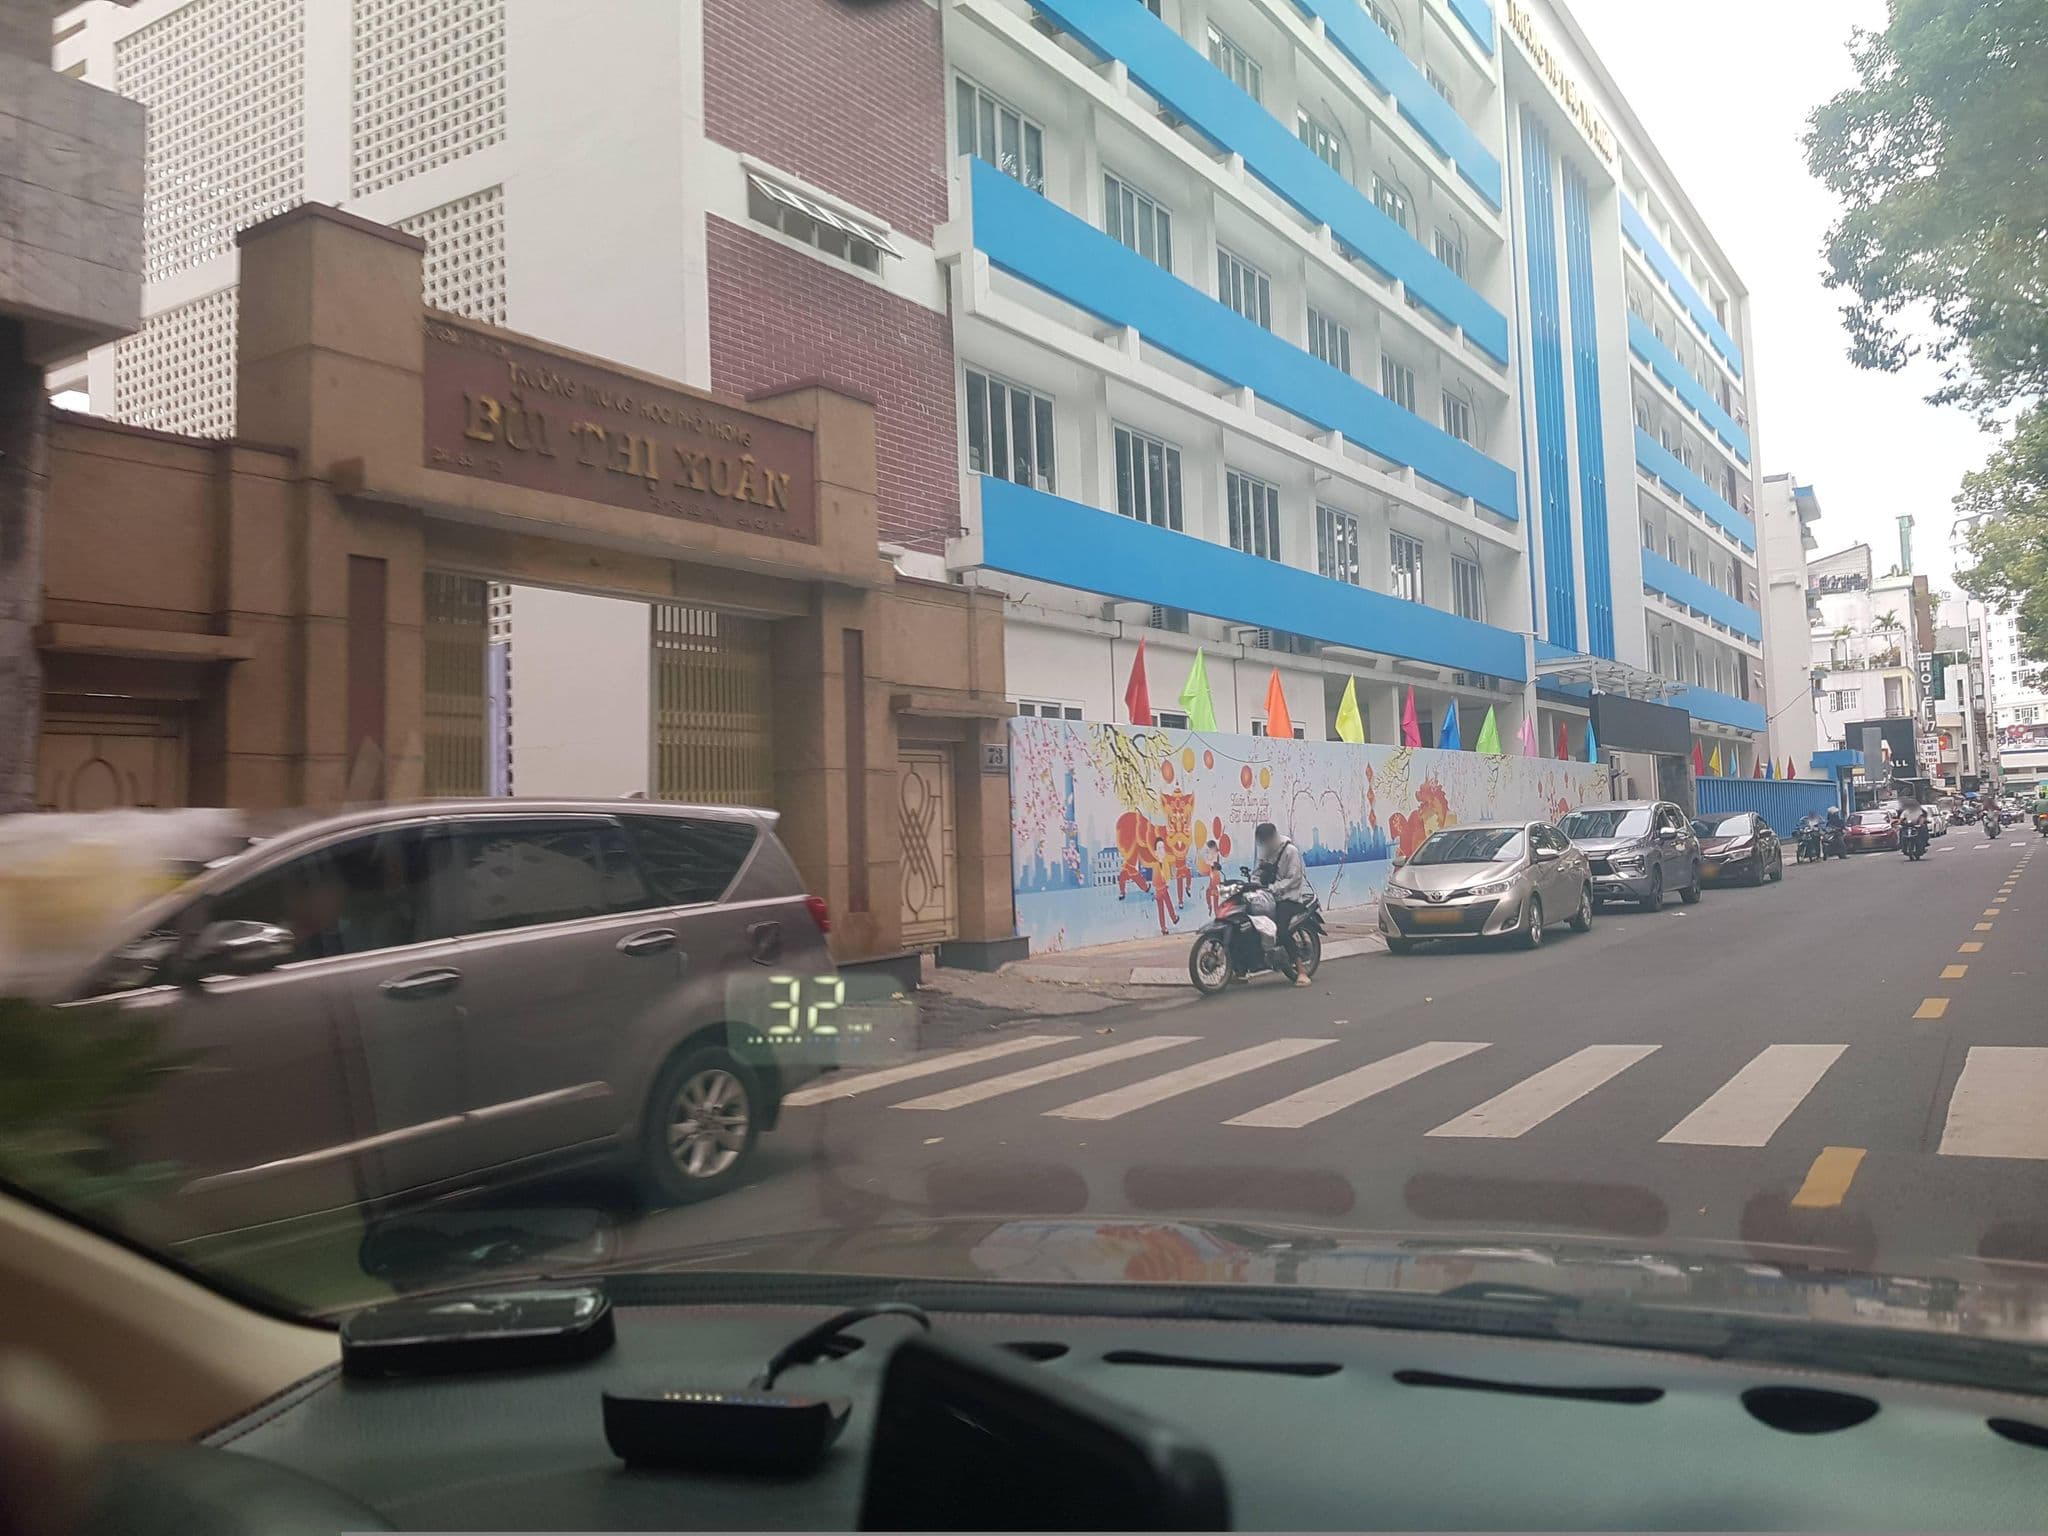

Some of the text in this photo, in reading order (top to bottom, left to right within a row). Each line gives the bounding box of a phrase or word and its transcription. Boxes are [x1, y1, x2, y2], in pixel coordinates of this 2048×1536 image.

[463, 388, 556, 457] BÙI
[568, 419, 660, 491] THỊ
[674, 446, 791, 512] XUÂN
[1920, 661, 1933, 717] HOTEL
[768, 976, 845, 1034] 32
